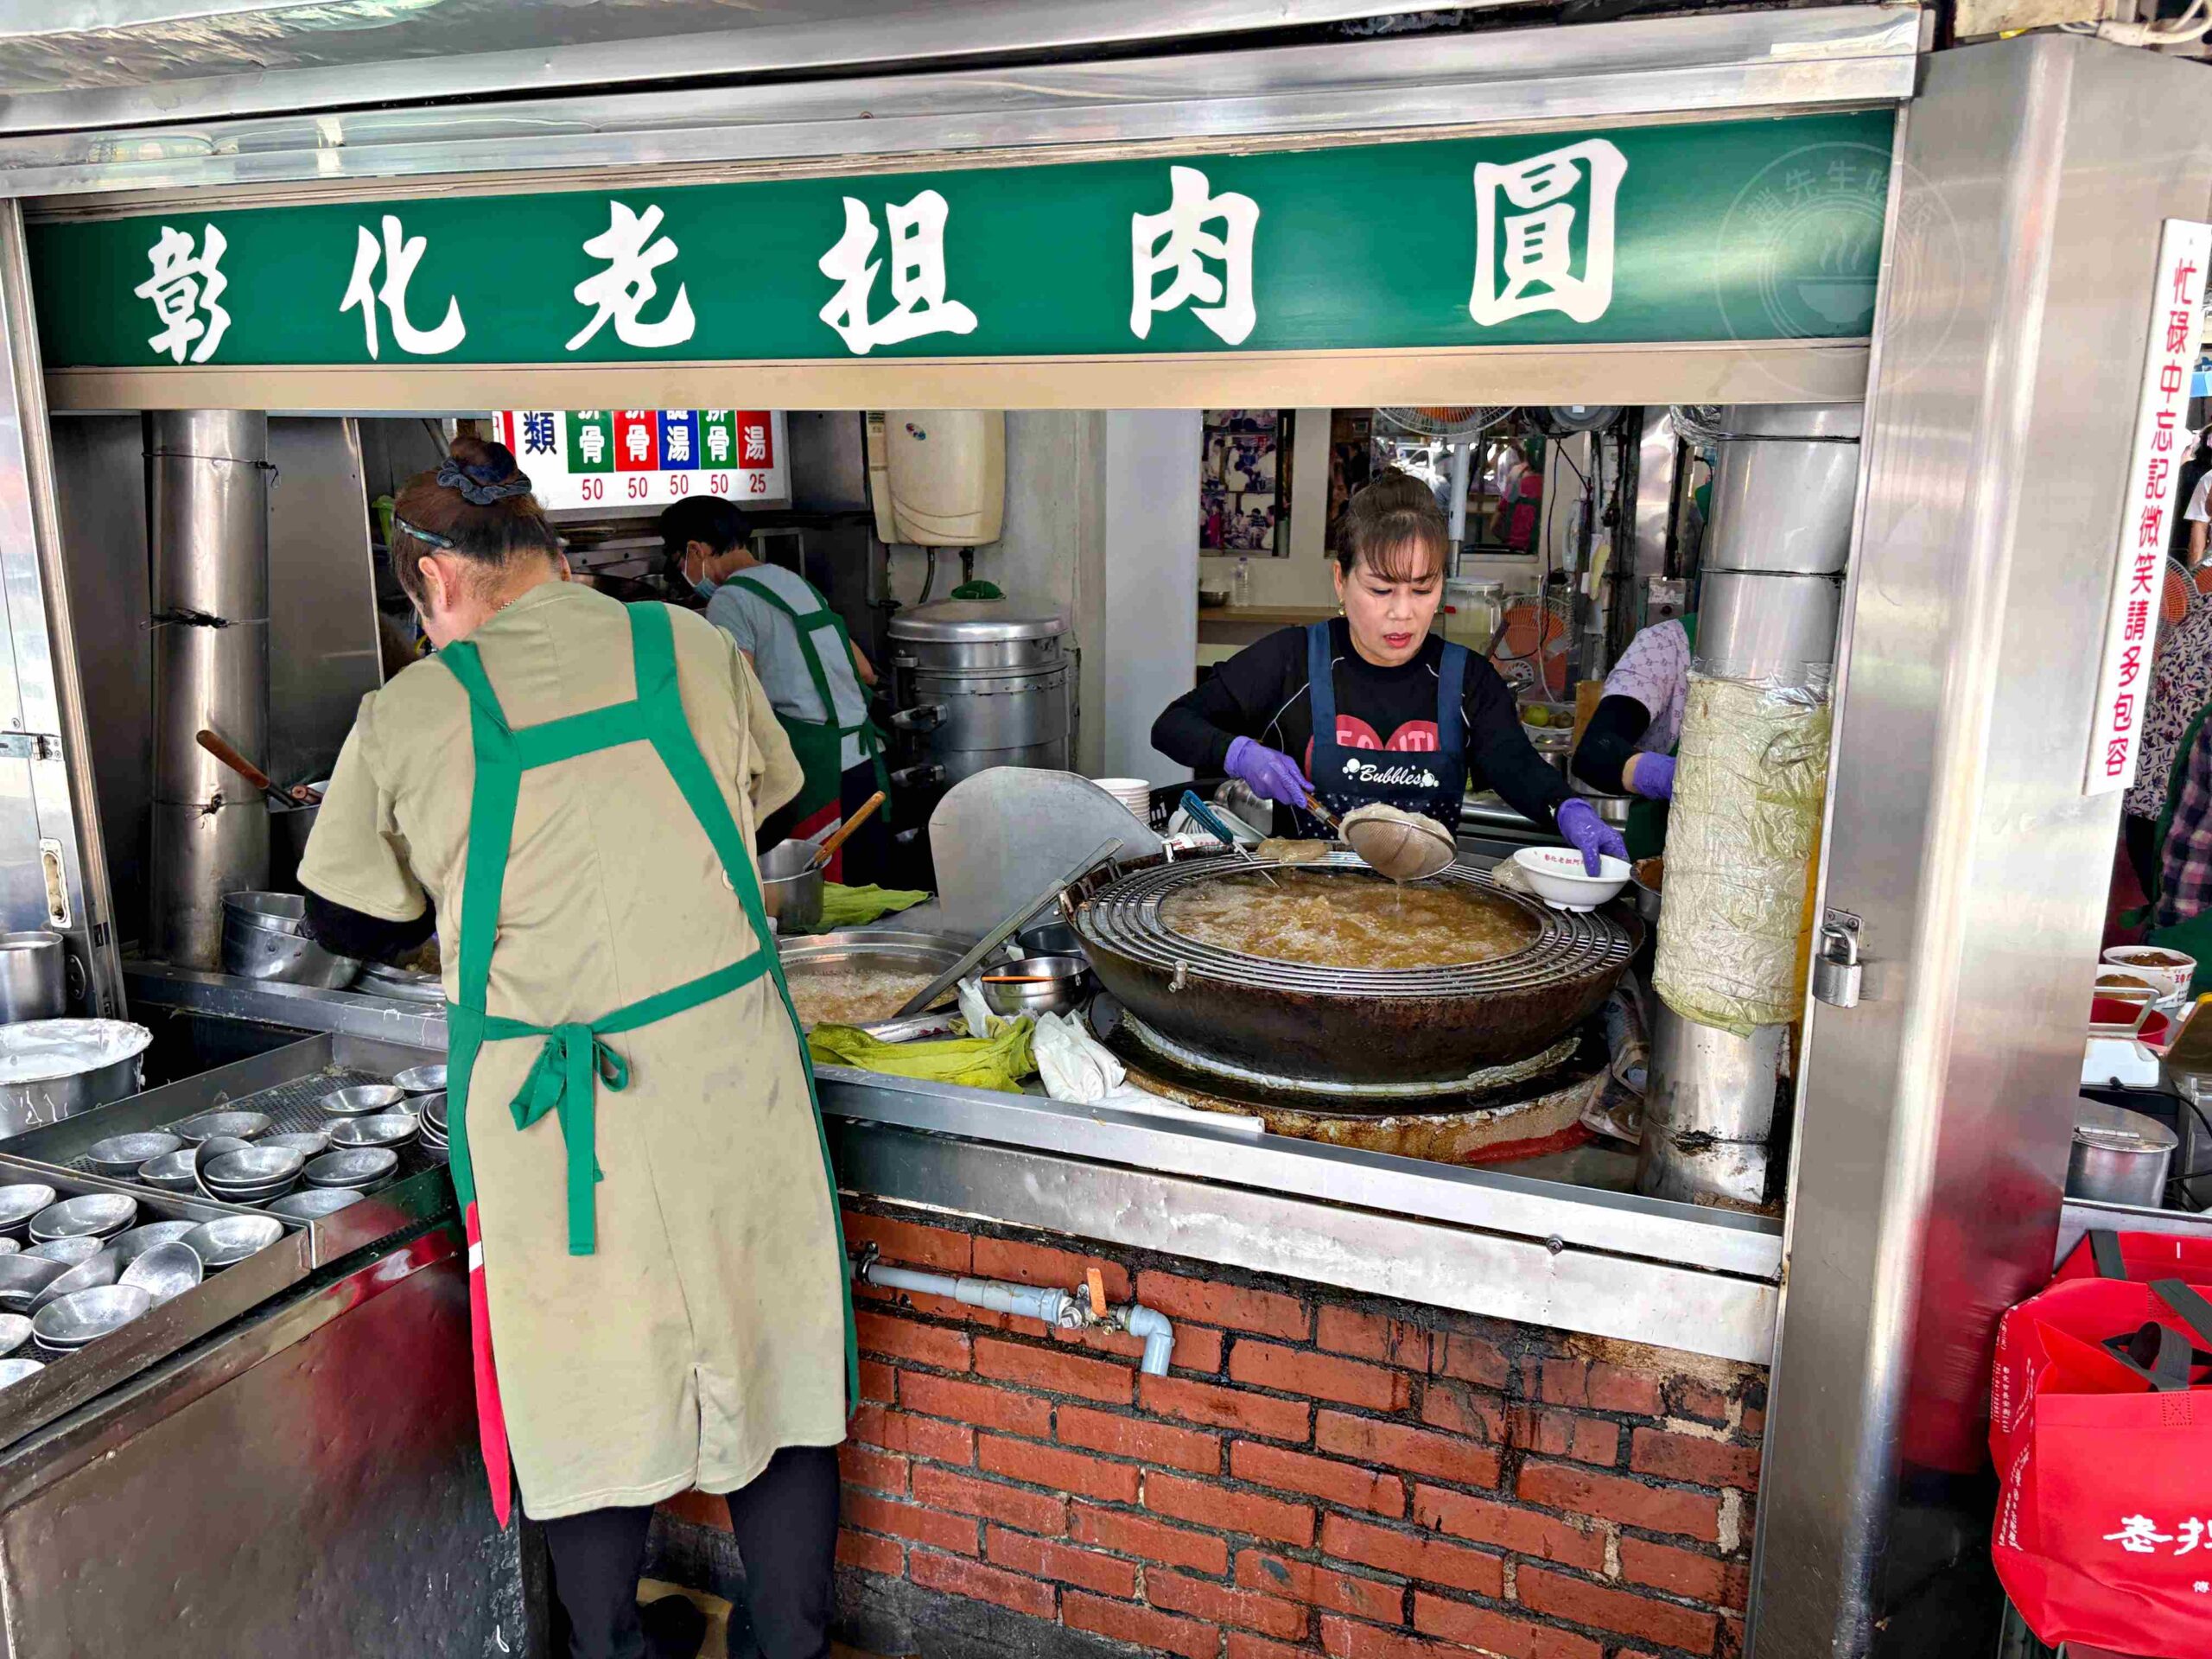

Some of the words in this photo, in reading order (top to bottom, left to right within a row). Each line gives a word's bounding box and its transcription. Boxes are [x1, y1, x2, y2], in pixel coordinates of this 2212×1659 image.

[582, 478, 603, 500] 50
[627, 477, 648, 499] 50
[670, 474, 689, 495] 50
[710, 474, 728, 493] 50
[749, 474, 766, 493] 25
[2105, 257, 2196, 777] 忙碌中忘記微笑請多包容
[1360, 764, 1421, 785] Bubbles
